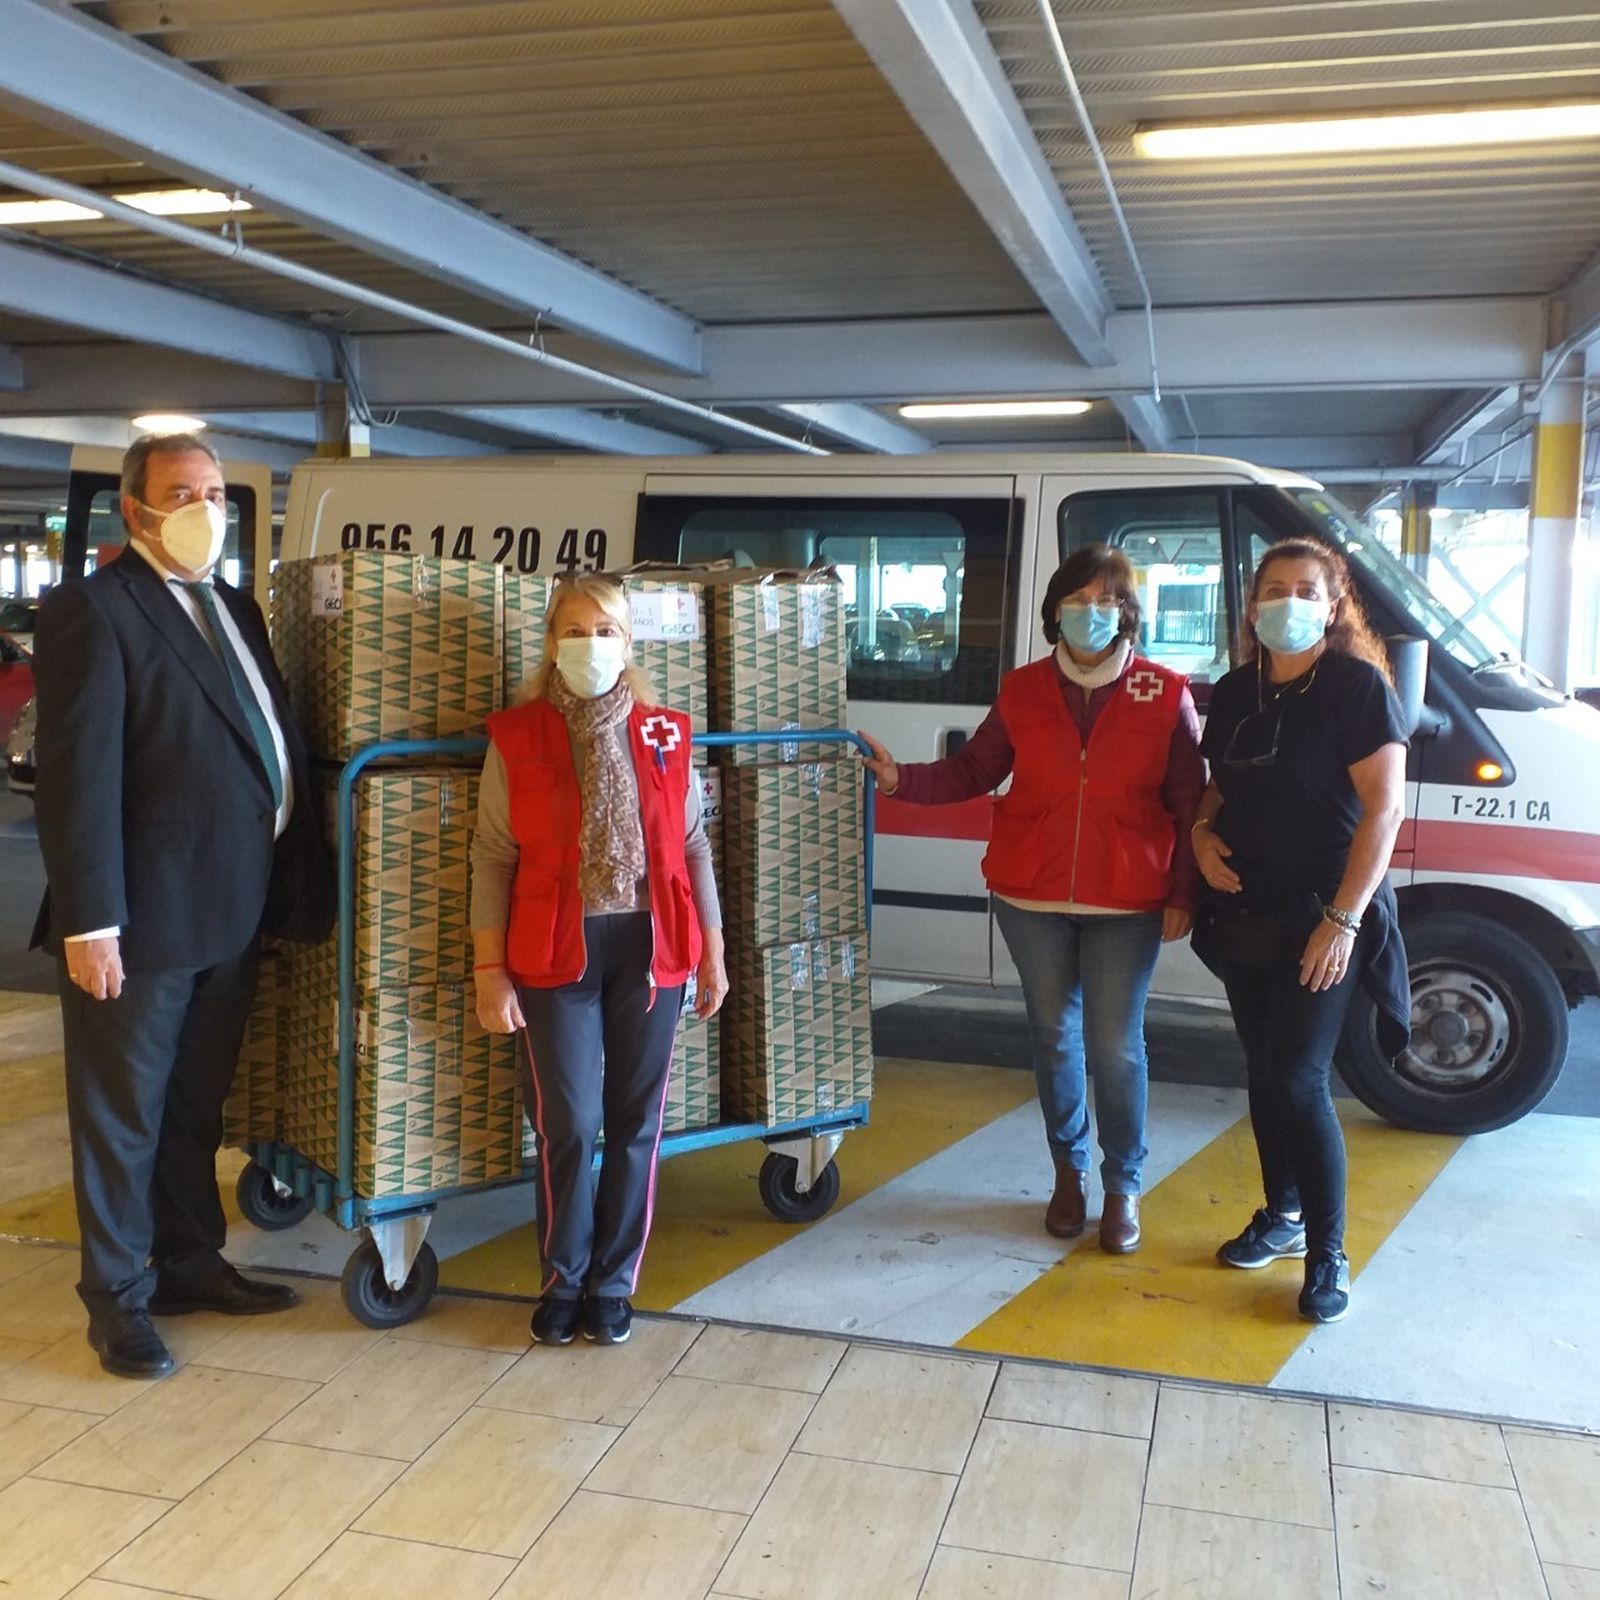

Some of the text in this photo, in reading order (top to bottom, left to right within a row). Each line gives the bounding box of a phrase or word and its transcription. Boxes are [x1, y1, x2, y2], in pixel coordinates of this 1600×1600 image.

[341, 522, 607, 574] 956 14 20 49
[661, 623, 696, 634] GECI
[1451, 795, 1551, 821] T-22.1 CA
